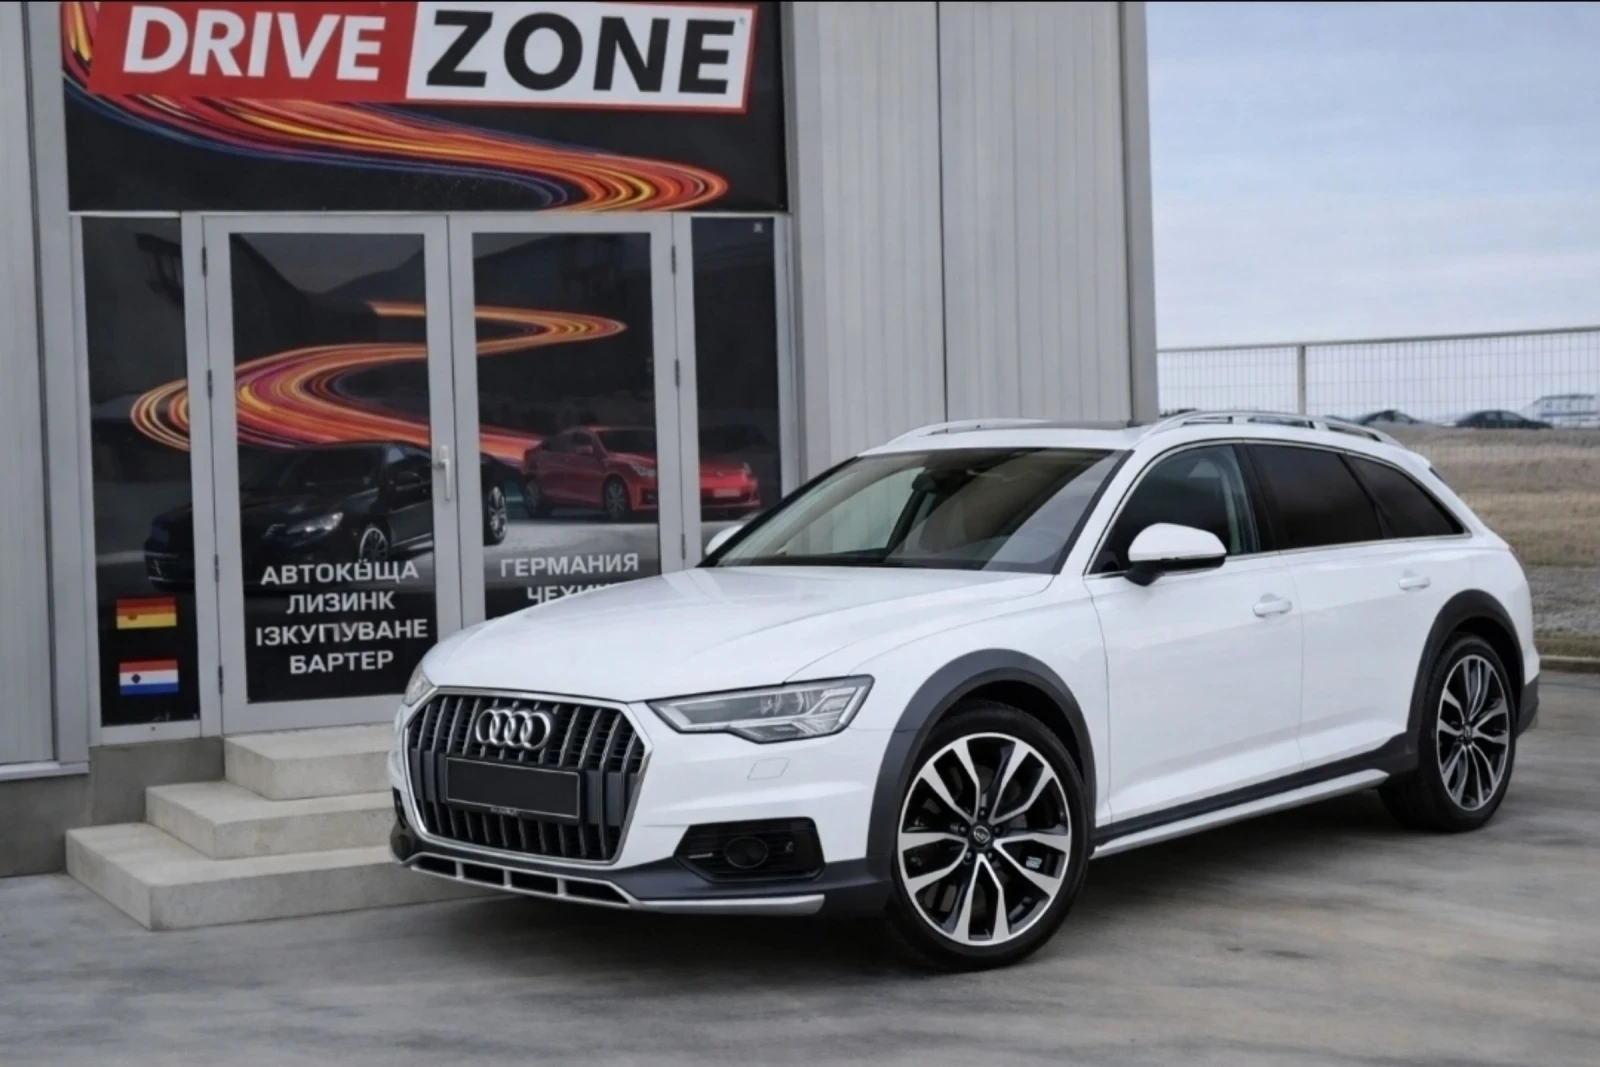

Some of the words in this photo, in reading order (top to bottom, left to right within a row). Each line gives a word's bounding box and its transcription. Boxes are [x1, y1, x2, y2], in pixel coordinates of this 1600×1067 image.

[122, 5, 386, 81] DRIVE
[426, 9, 736, 94] ZONE
[500, 553, 638, 577] ГЕРМАНИЯ
[286, 591, 395, 614] ЛИЗИНК
[527, 584, 612, 605] ЧЕХ
[289, 650, 394, 674] БАРТЕР
